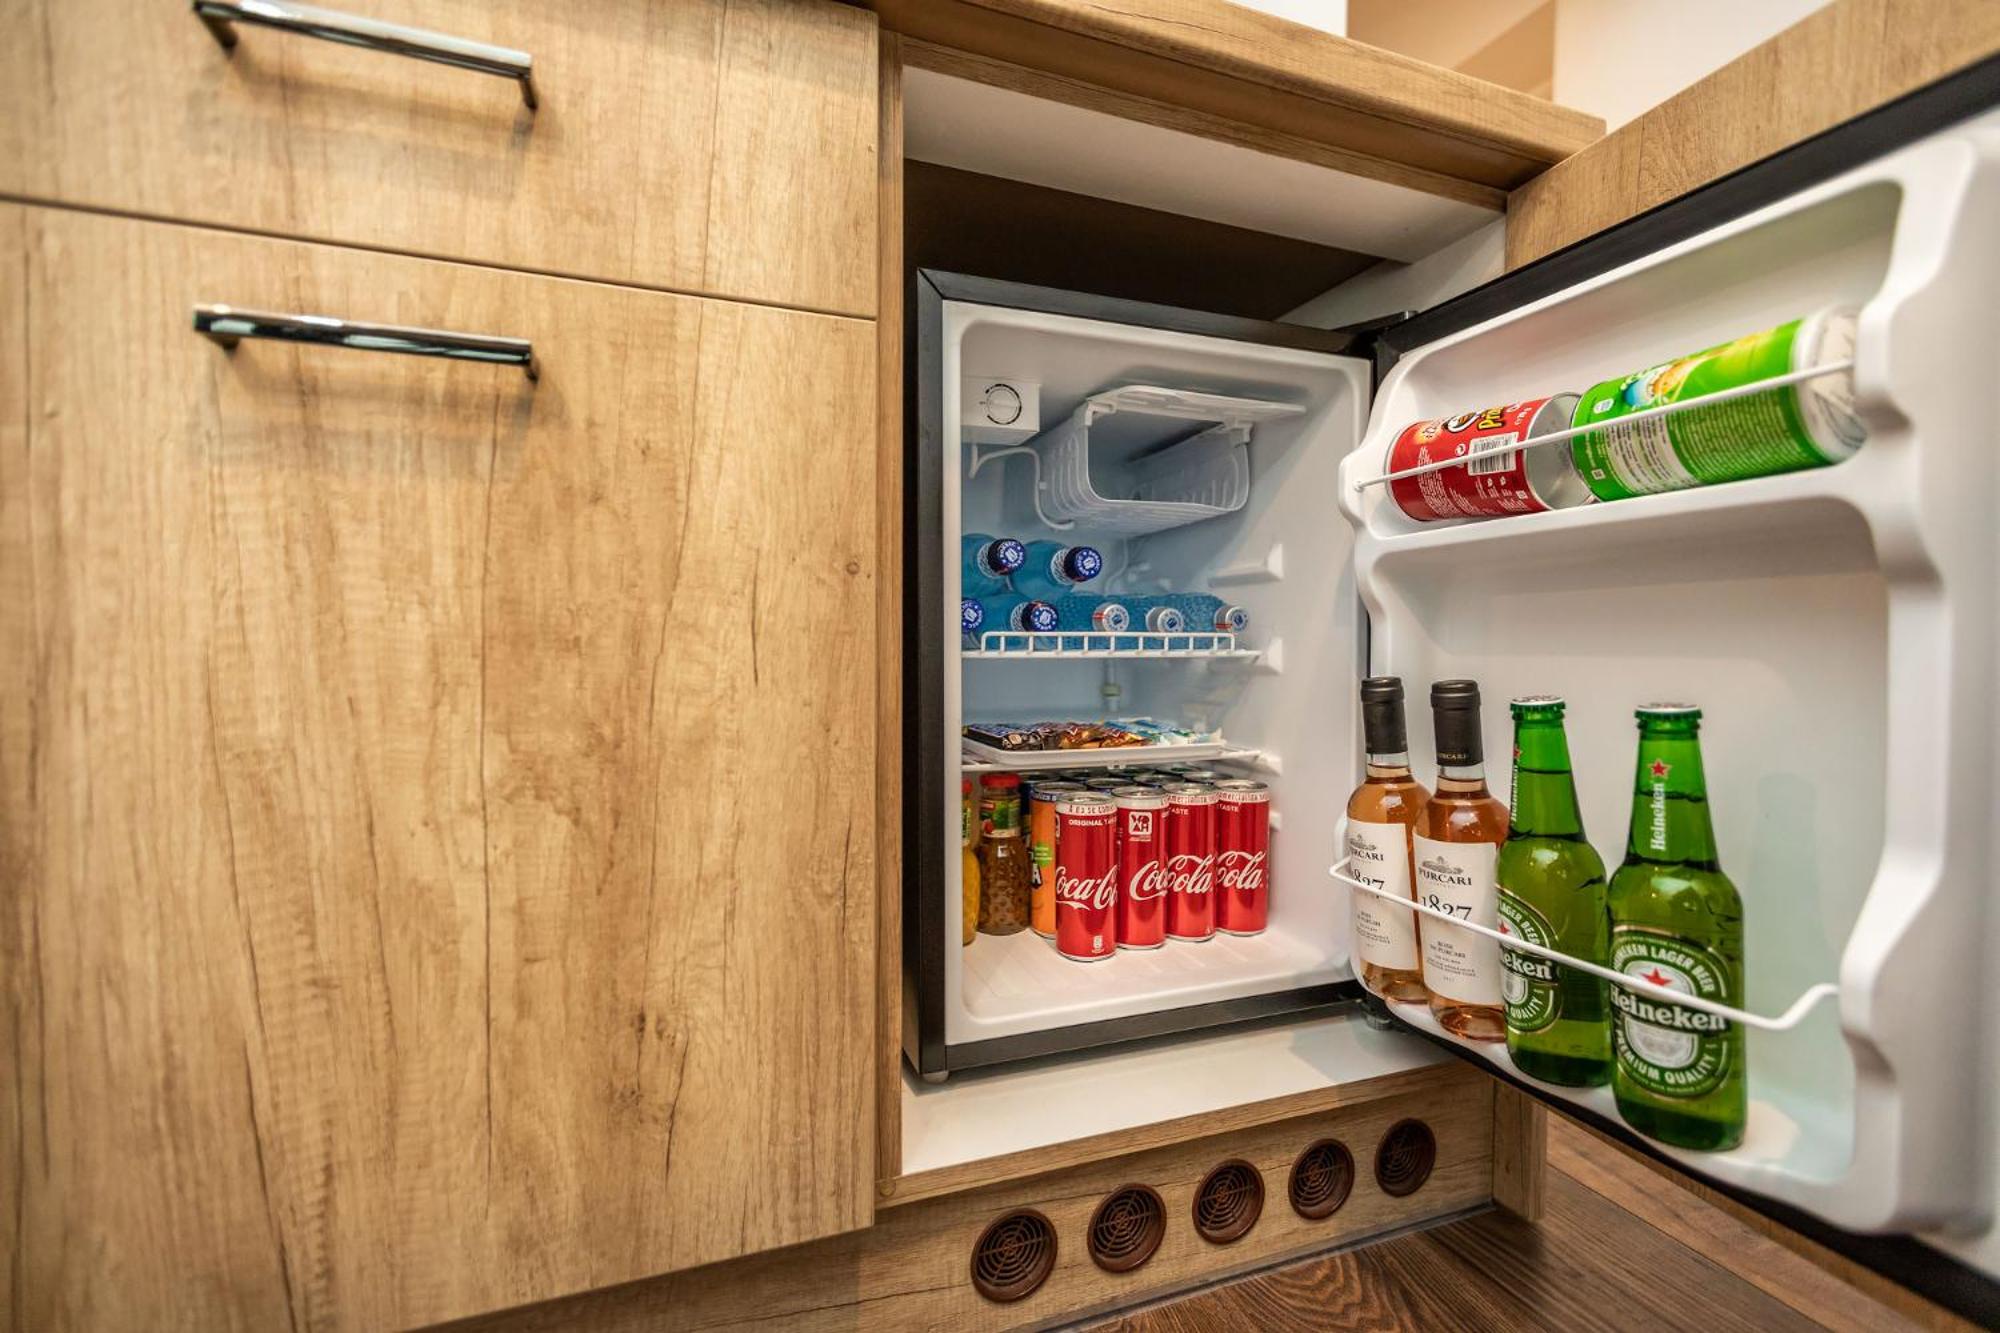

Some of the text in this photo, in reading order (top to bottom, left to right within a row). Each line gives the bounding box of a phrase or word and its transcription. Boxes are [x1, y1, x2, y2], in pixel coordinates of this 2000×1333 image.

[1068, 818, 1104, 827] ORIGINAL
[1649, 782, 1667, 851] Heineken
[1418, 867, 1472, 886] PURCARI
[1651, 946, 1695, 970] LAGER
[1691, 960, 1716, 993] BEER
[1610, 982, 1727, 1031] Heineken
[1664, 1052, 1717, 1085] QUALITY
